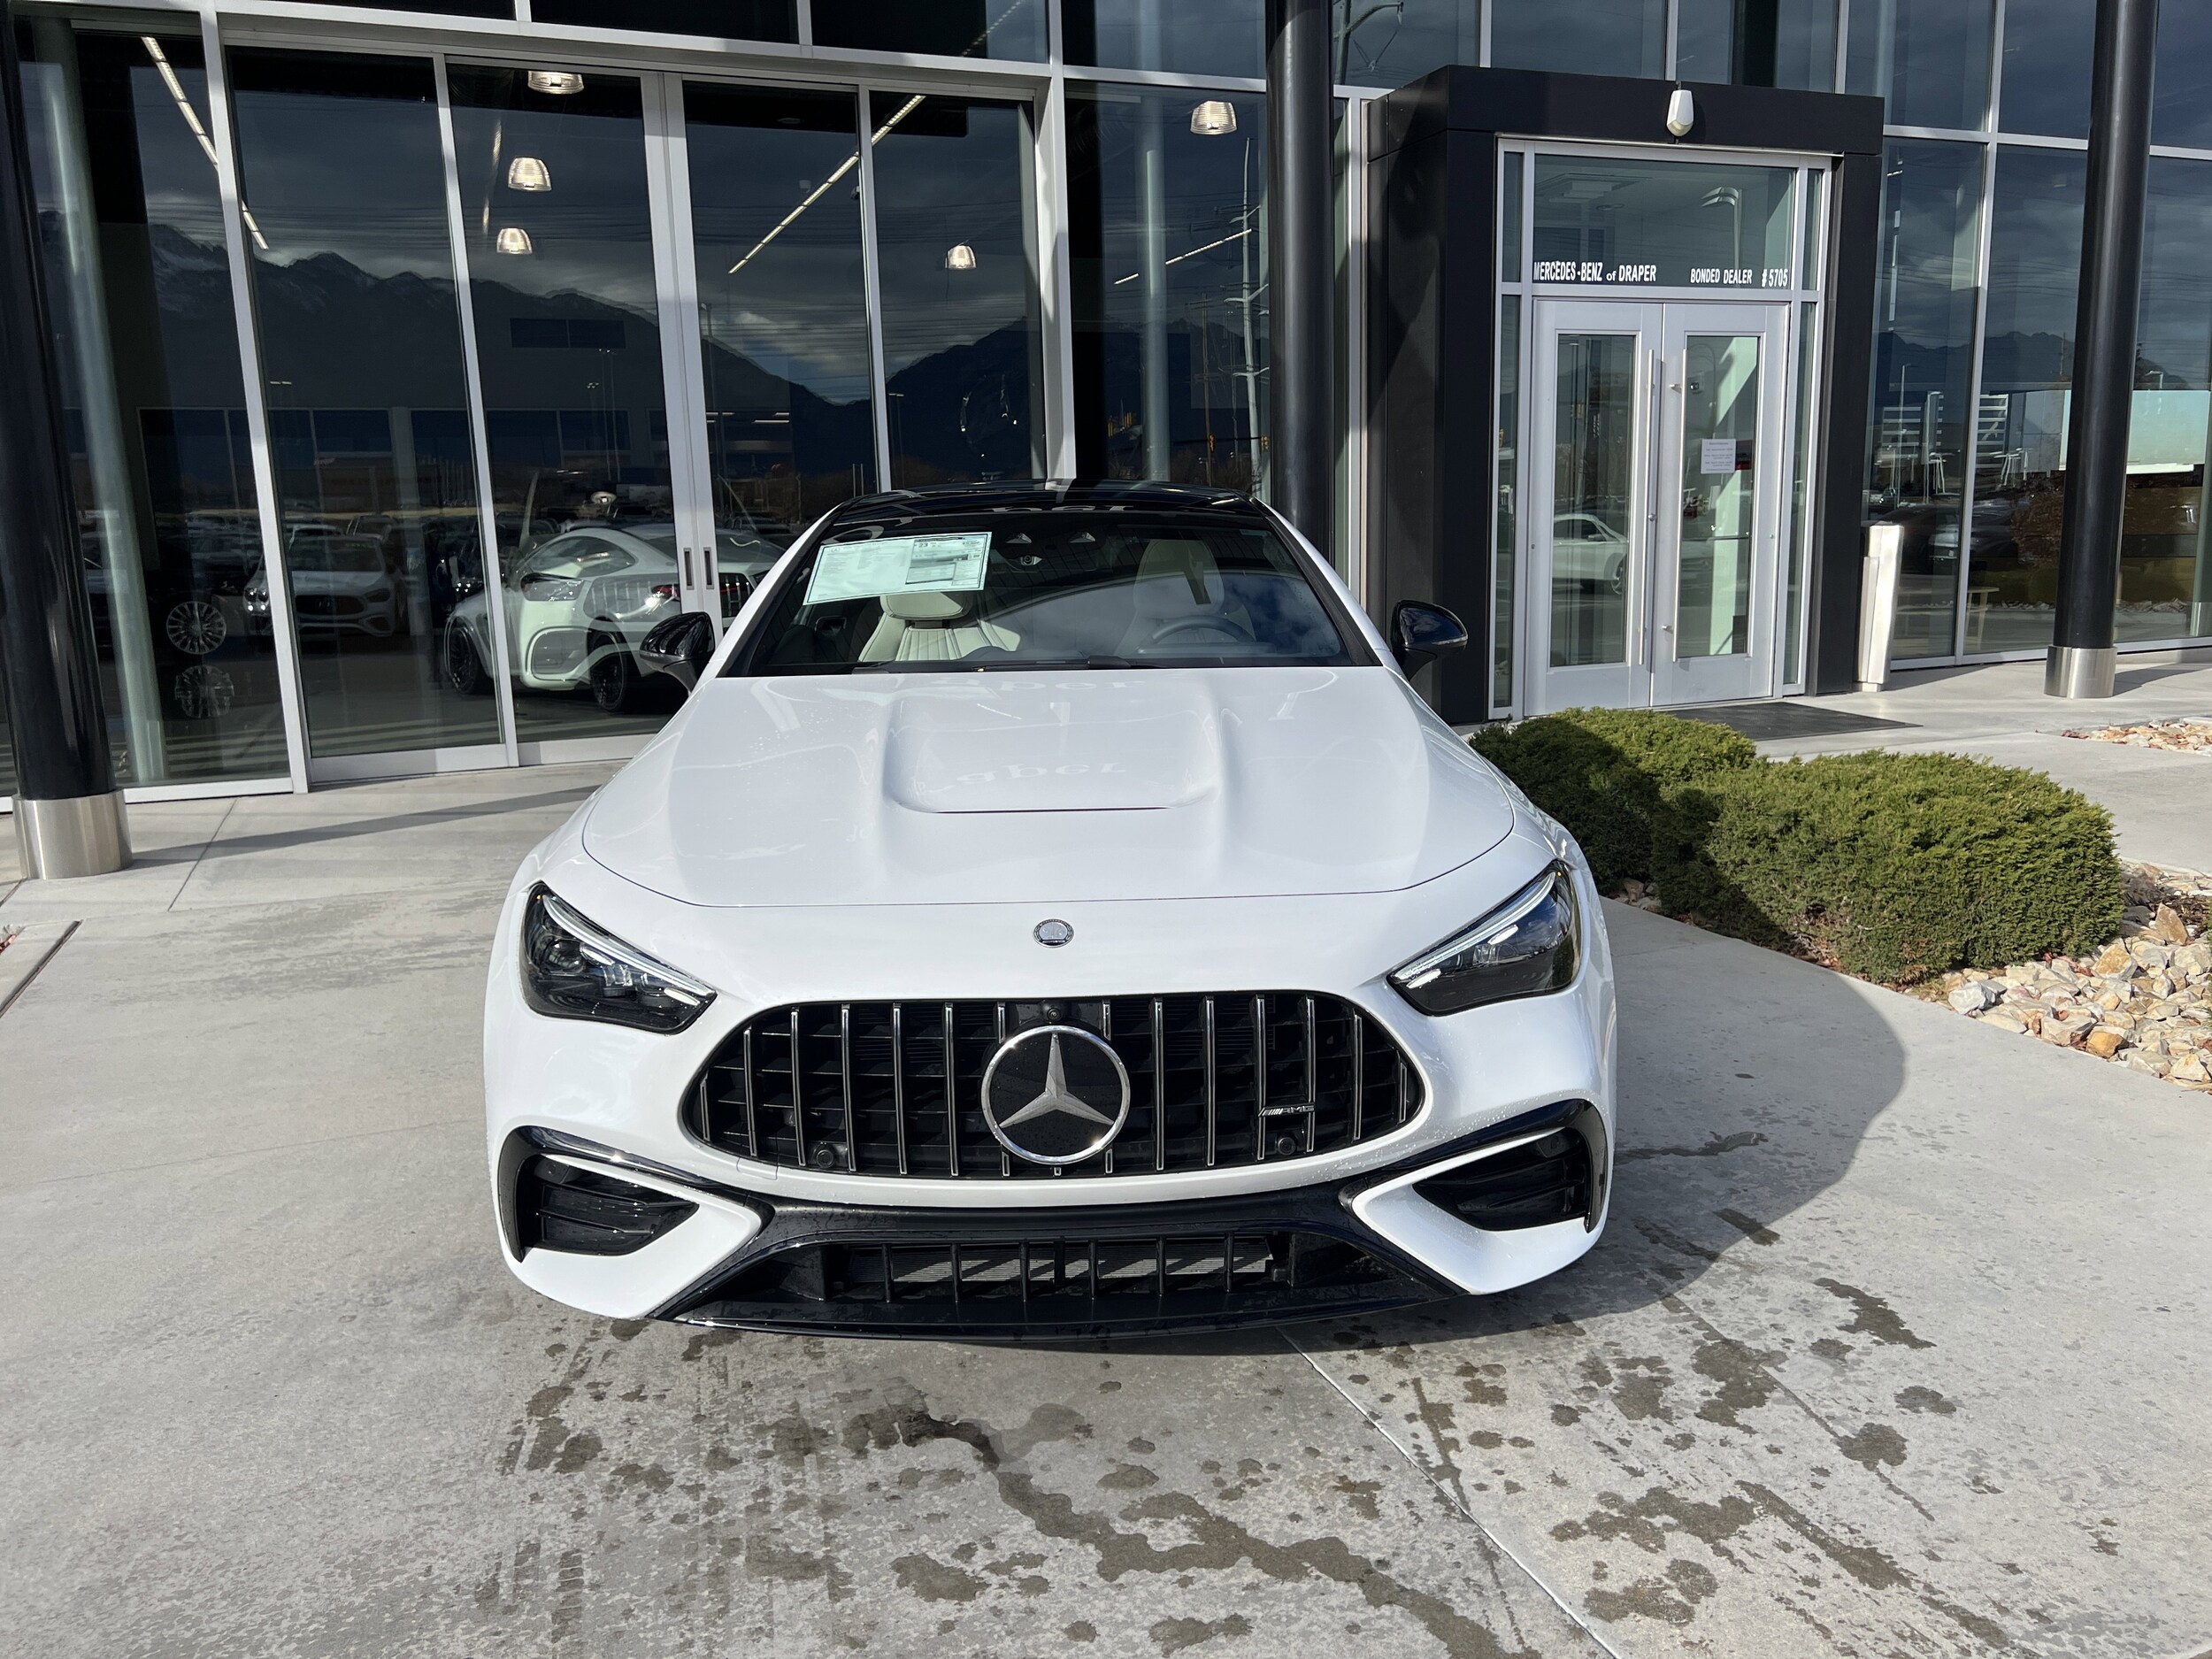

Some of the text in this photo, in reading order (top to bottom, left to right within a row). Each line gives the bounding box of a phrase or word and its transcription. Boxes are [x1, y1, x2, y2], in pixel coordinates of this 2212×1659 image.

[1606, 270, 1617, 281] of
[1618, 265, 1657, 281] DRAPER
[1690, 268, 1720, 283] BONDED
[1723, 269, 1753, 284] DEALER
